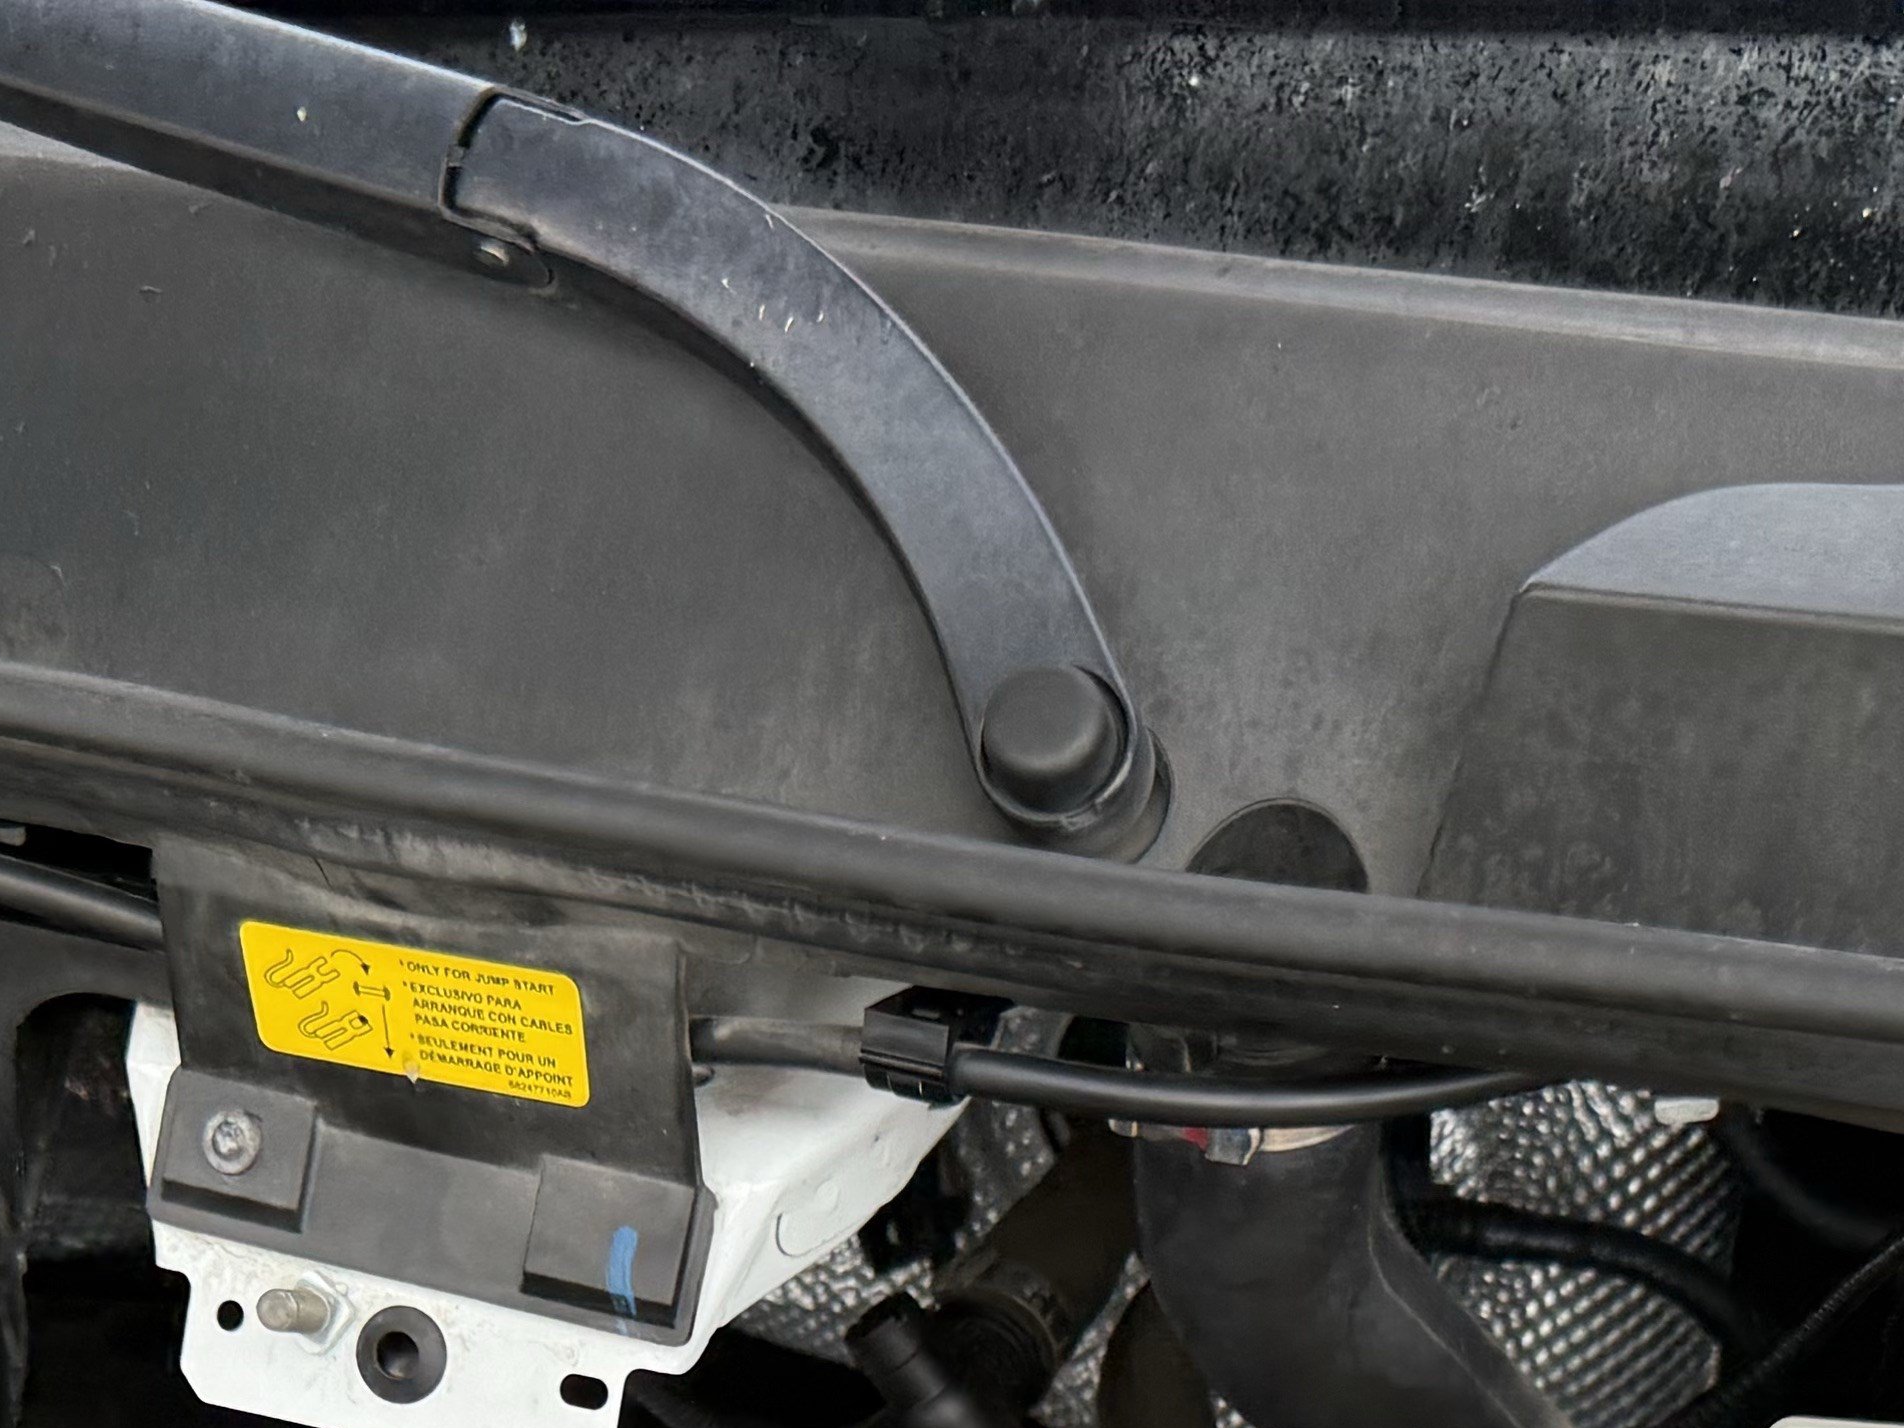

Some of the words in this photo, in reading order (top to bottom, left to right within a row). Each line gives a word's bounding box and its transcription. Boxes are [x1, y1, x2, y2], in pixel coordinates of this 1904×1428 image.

[406, 960, 440, 976] ONLY
[444, 967, 471, 982] FOR
[475, 973, 510, 987] JUMP
[513, 979, 554, 996] START
[409, 981, 483, 1004] EXCLUSIVO
[486, 994, 523, 1011] PARA
[412, 997, 485, 1021] ARRANQUE
[488, 1010, 516, 1026] CON
[414, 1013, 449, 1030] PASA
[451, 1020, 526, 1044] CORRIENTE
[417, 1034, 494, 1057] SEULEMENT
[497, 1049, 535, 1066] POUR
[538, 1056, 557, 1069] UN
[504, 1066, 574, 1087] D'APPOINT
